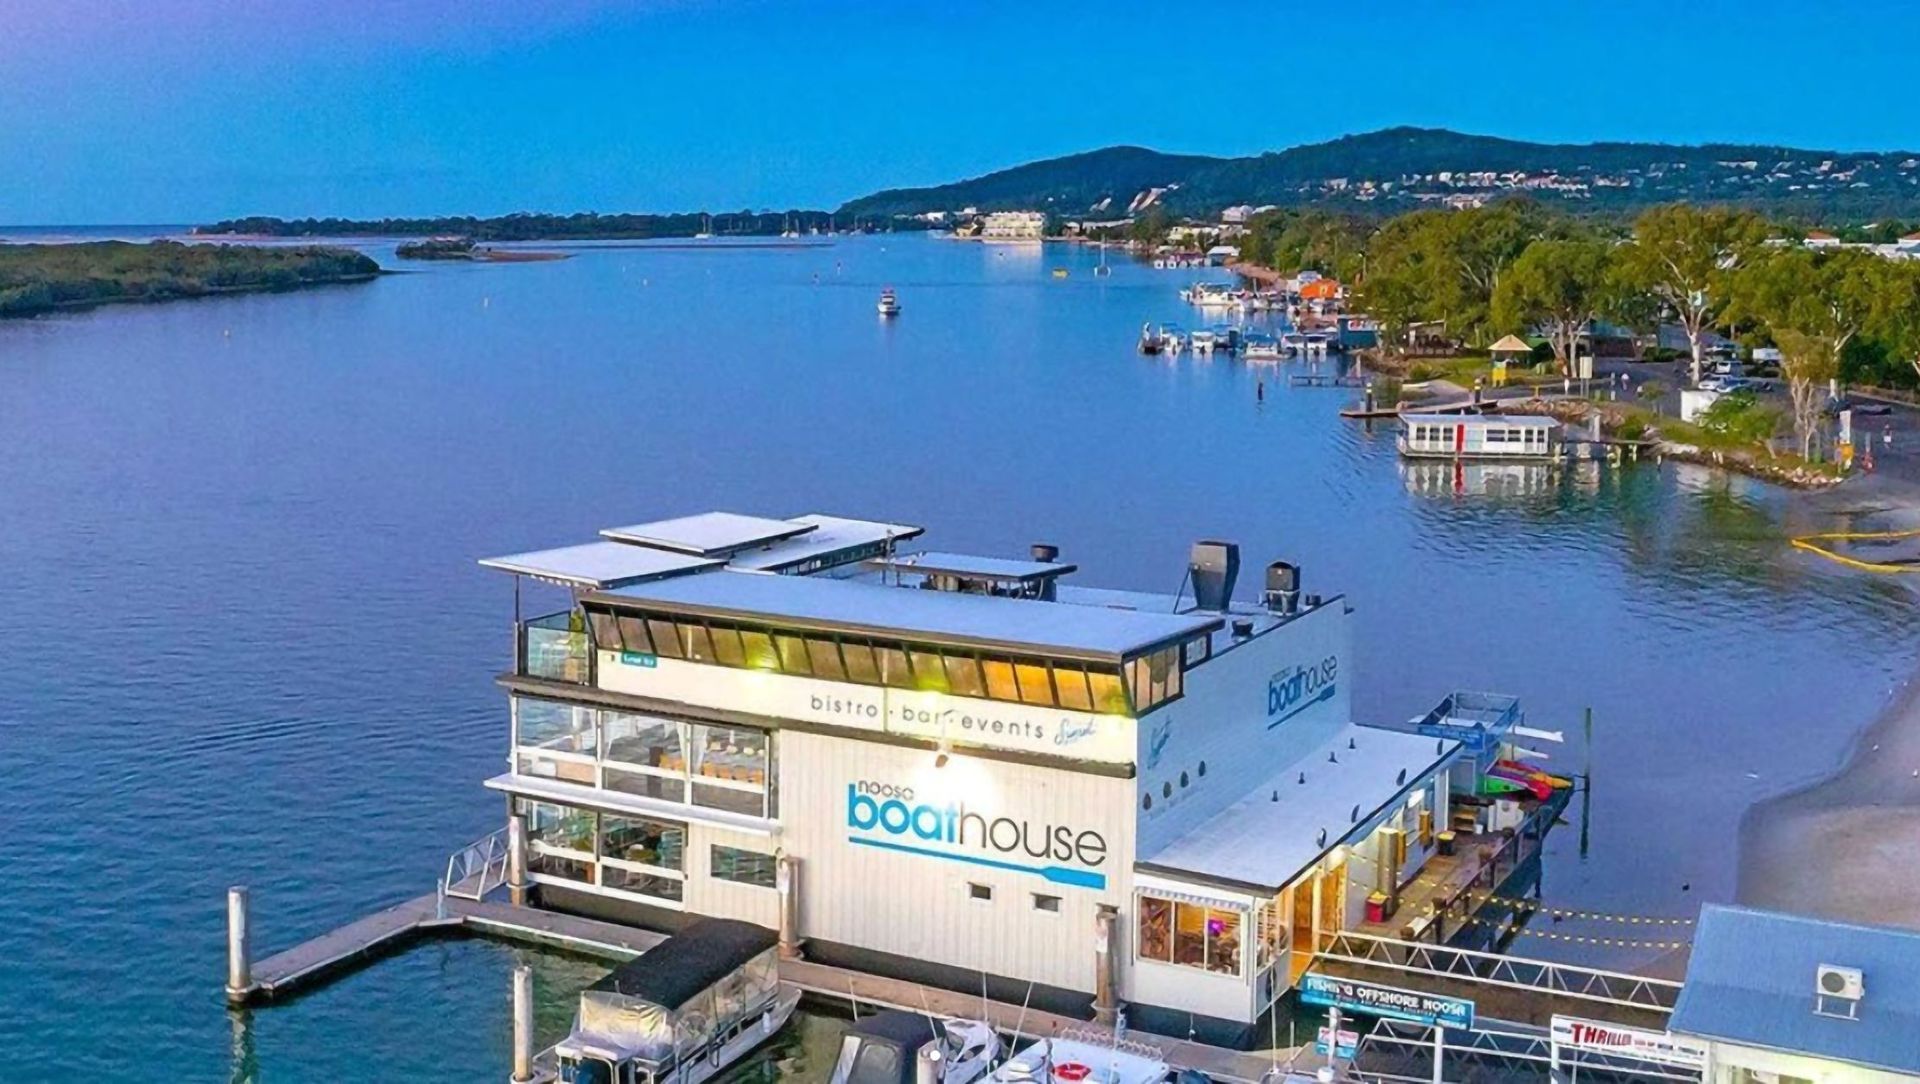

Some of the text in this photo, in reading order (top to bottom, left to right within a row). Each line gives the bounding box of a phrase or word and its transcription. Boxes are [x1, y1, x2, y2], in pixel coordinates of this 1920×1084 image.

[1268, 655, 1337, 716] boathouse
[810, 694, 879, 718] bistro
[902, 704, 939, 724] bar
[961, 715, 1044, 739] events
[857, 779, 915, 801] noosa
[847, 783, 1108, 867] boathouse
[1356, 987, 1420, 1009] OFFSHORE
[1423, 999, 1466, 1017] NOOSA
